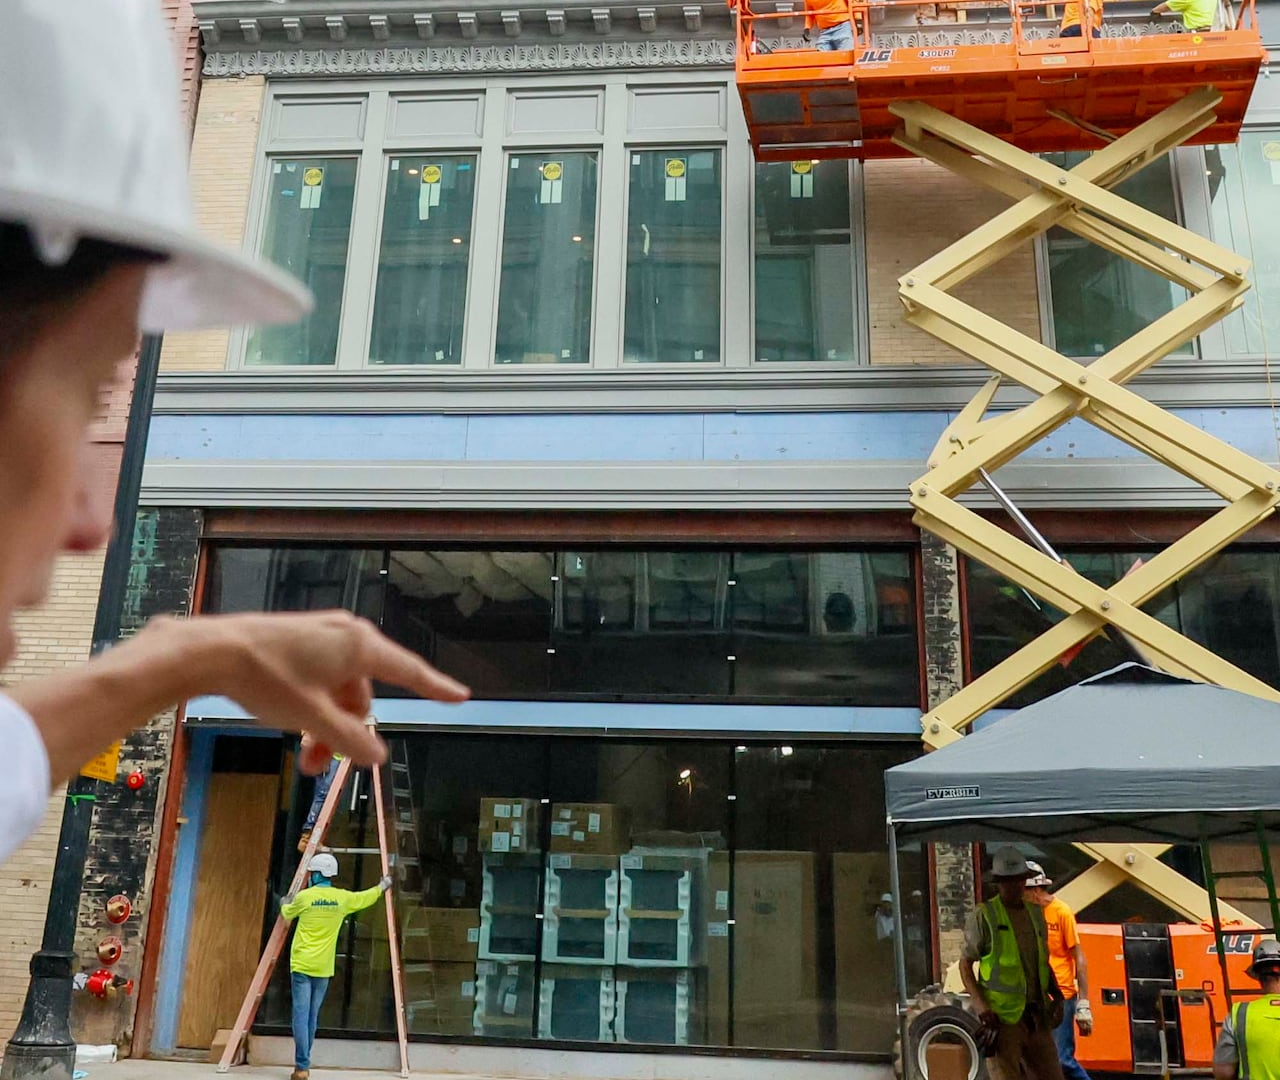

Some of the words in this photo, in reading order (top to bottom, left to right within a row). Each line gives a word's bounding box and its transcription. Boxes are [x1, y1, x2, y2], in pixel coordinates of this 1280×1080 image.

[857, 49, 892, 63] JLG
[919, 49, 956, 58] 430LRT
[927, 787, 978, 798] EVERBILT
